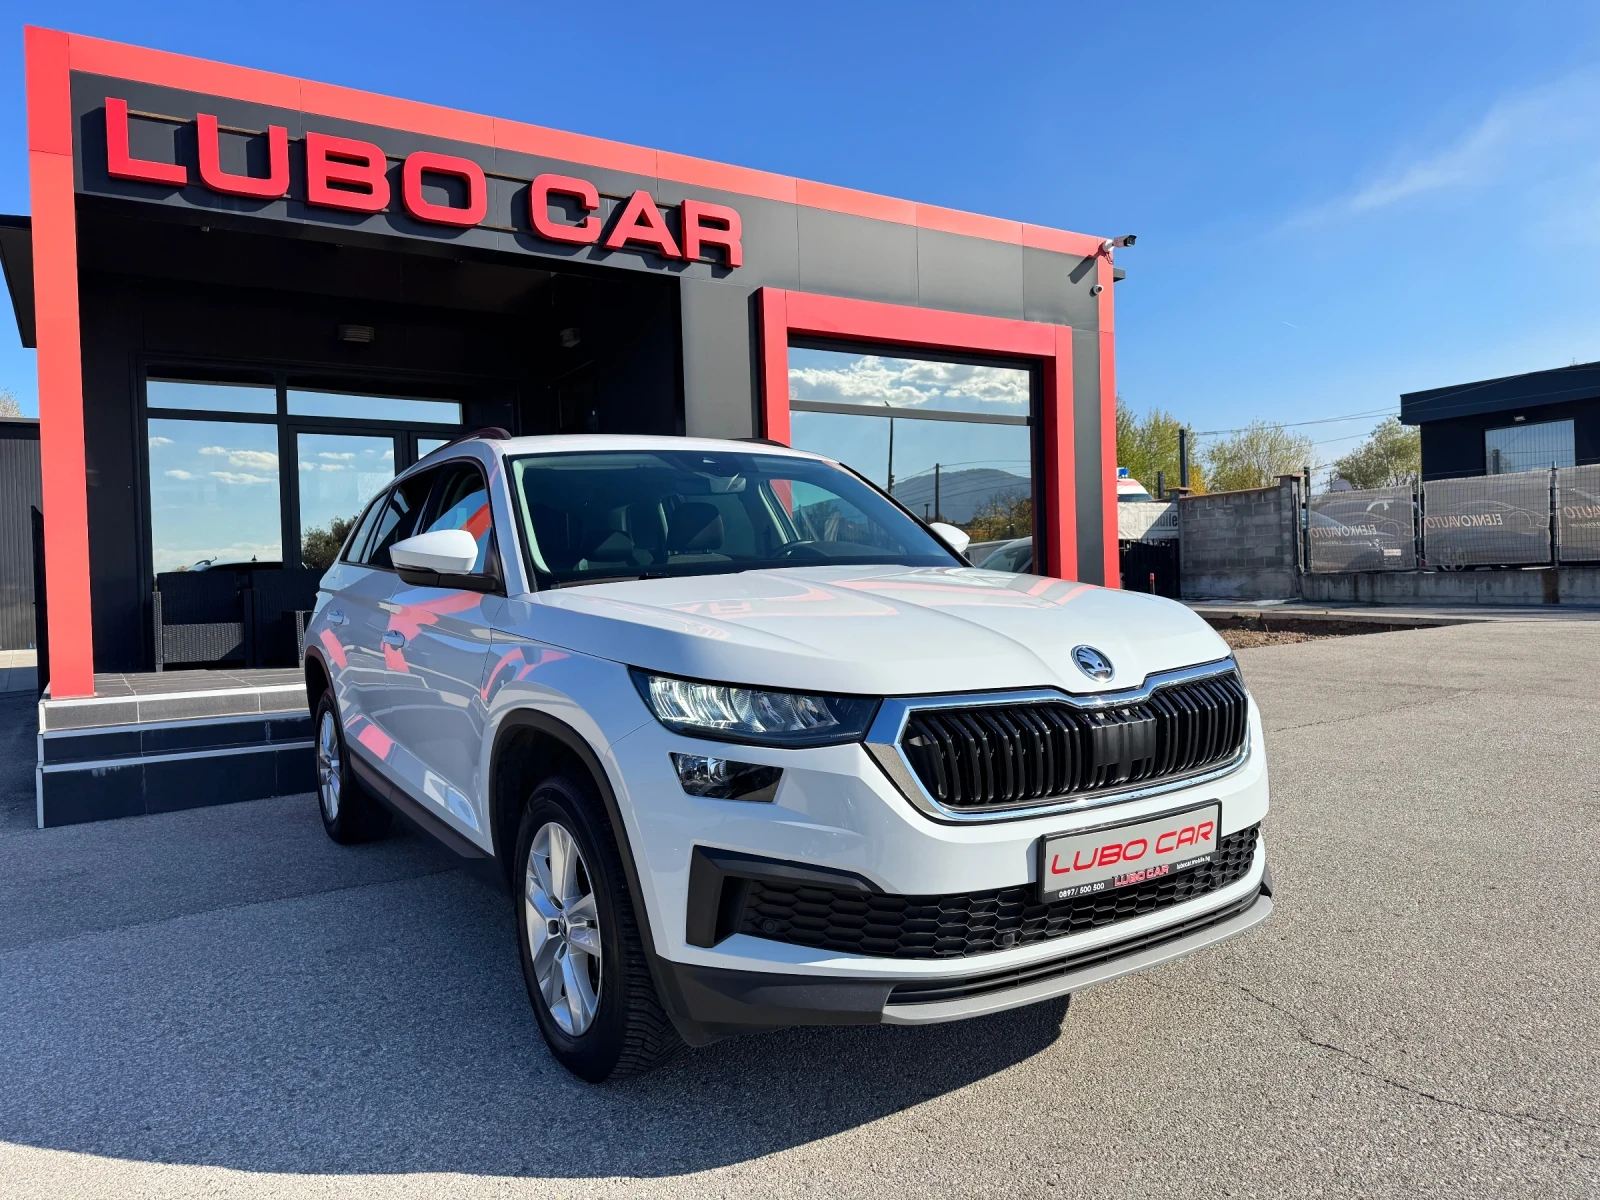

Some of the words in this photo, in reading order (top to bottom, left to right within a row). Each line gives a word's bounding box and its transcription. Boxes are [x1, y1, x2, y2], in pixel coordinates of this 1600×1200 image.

[104, 97, 487, 228] LUBO
[528, 173, 743, 269] CAR
[1051, 838, 1148, 875] LUBO
[1155, 820, 1214, 855] CAR
[1080, 885, 1092, 894] 500
[1093, 882, 1105, 891] 500
[1114, 871, 1145, 887] LUBO
[1147, 865, 1169, 879] CAR
